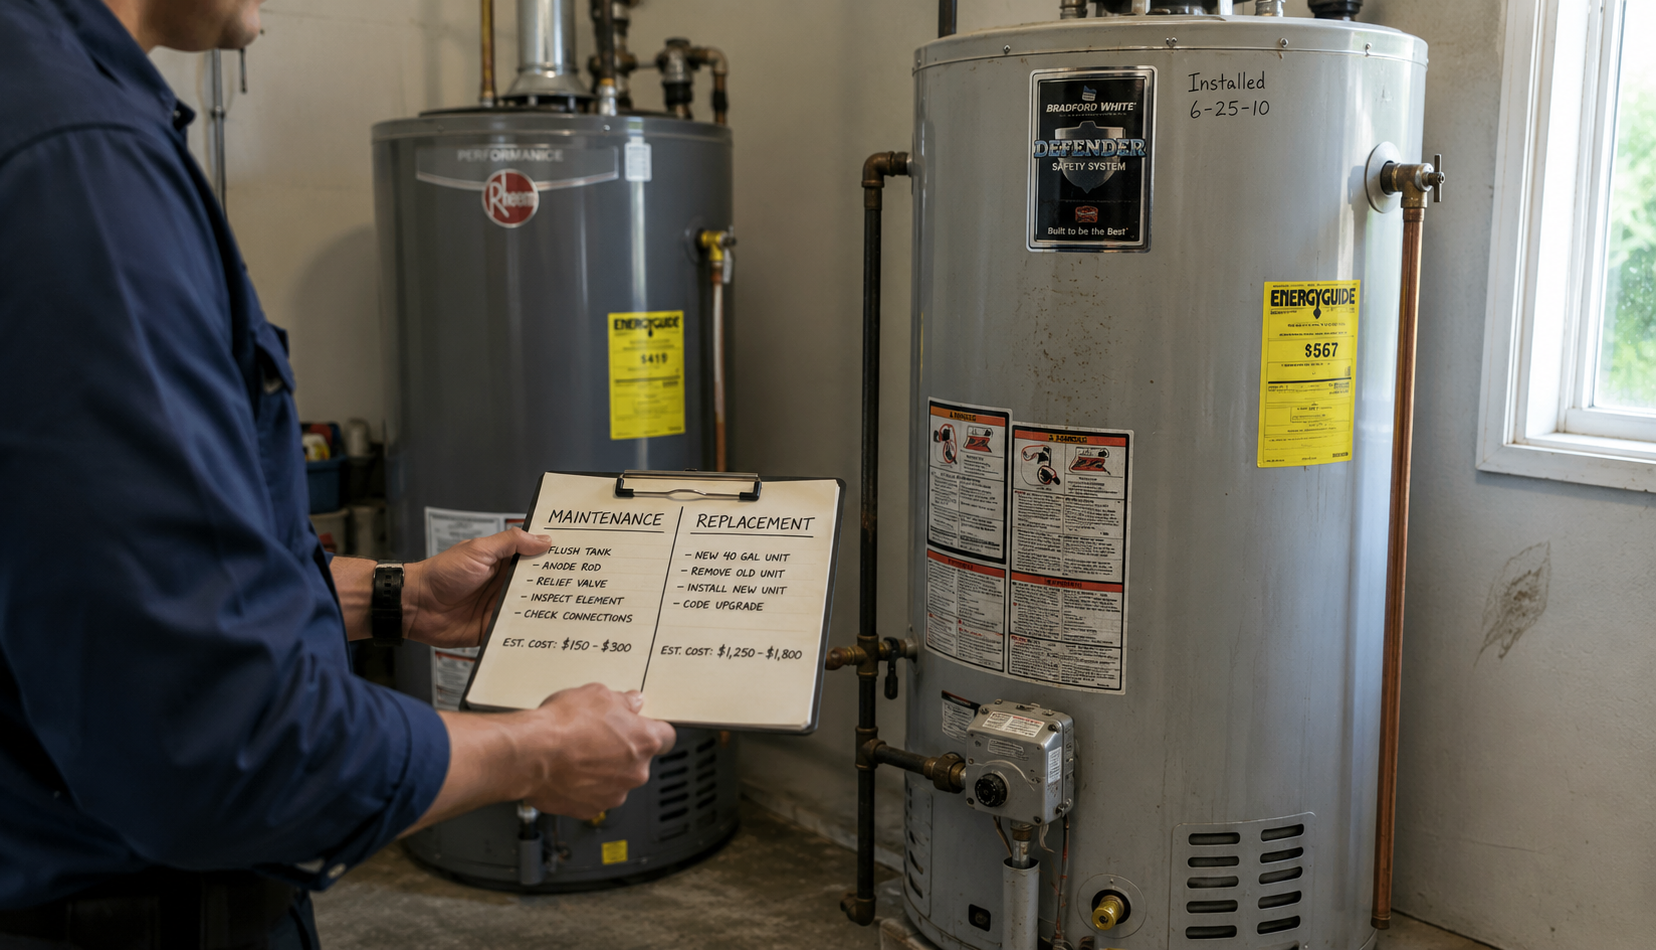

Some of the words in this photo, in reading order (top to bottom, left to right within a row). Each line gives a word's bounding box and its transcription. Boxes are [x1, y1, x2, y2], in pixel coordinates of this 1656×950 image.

[1187, 70, 1267, 93] Installed
[1045, 102, 1098, 113] BRADFORD
[1100, 101, 1134, 112] WHITE
[1189, 99, 1271, 120] 6-25-10
[1033, 138, 1147, 158] DEFENDER
[1052, 162, 1086, 172] SAFETY
[1087, 161, 1127, 171] SYSTEM
[1047, 226, 1066, 235] Built
[1067, 227, 1077, 236] to
[1078, 226, 1089, 236] be
[1091, 226, 1105, 236] the
[1270, 287, 1356, 308] ENERGYGUIDE
[1304, 341, 1339, 359] $567
[547, 508, 665, 527] MAINTENANCE
[695, 512, 816, 531] REPLACEMENT
[547, 545, 581, 556] FLUSH
[585, 546, 612, 557] TANK
[694, 550, 720, 561] NEW
[722, 551, 738, 561] 40
[740, 551, 761, 562] GAL
[764, 553, 791, 563] UNIT
[541, 560, 578, 572] ANODE
[580, 562, 602, 572] ROD
[690, 565, 733, 577] REMOVE
[735, 568, 756, 578] OLD
[759, 569, 786, 579] UNIT
[535, 576, 574, 588] RELIEF
[577, 578, 609, 589] VALVE
[686, 582, 728, 594] INSTALL
[731, 584, 758, 595] NEW
[761, 585, 788, 596] UNIT
[530, 592, 574, 604] INSPECT
[574, 594, 626, 606] ELEMENT
[682, 599, 711, 610] CODE
[715, 600, 765, 612] UPGRADE
[523, 609, 559, 620] CHECK
[562, 611, 634, 624] CONNECTIONS
[502, 637, 526, 648] EST.
[527, 639, 559, 650] COST:
[560, 636, 591, 652] $150
[601, 638, 633, 653] $300
[660, 644, 683, 656] EST.
[684, 646, 714, 657] COST:
[716, 643, 756, 660] $1,250
[765, 645, 803, 662] $1,800
